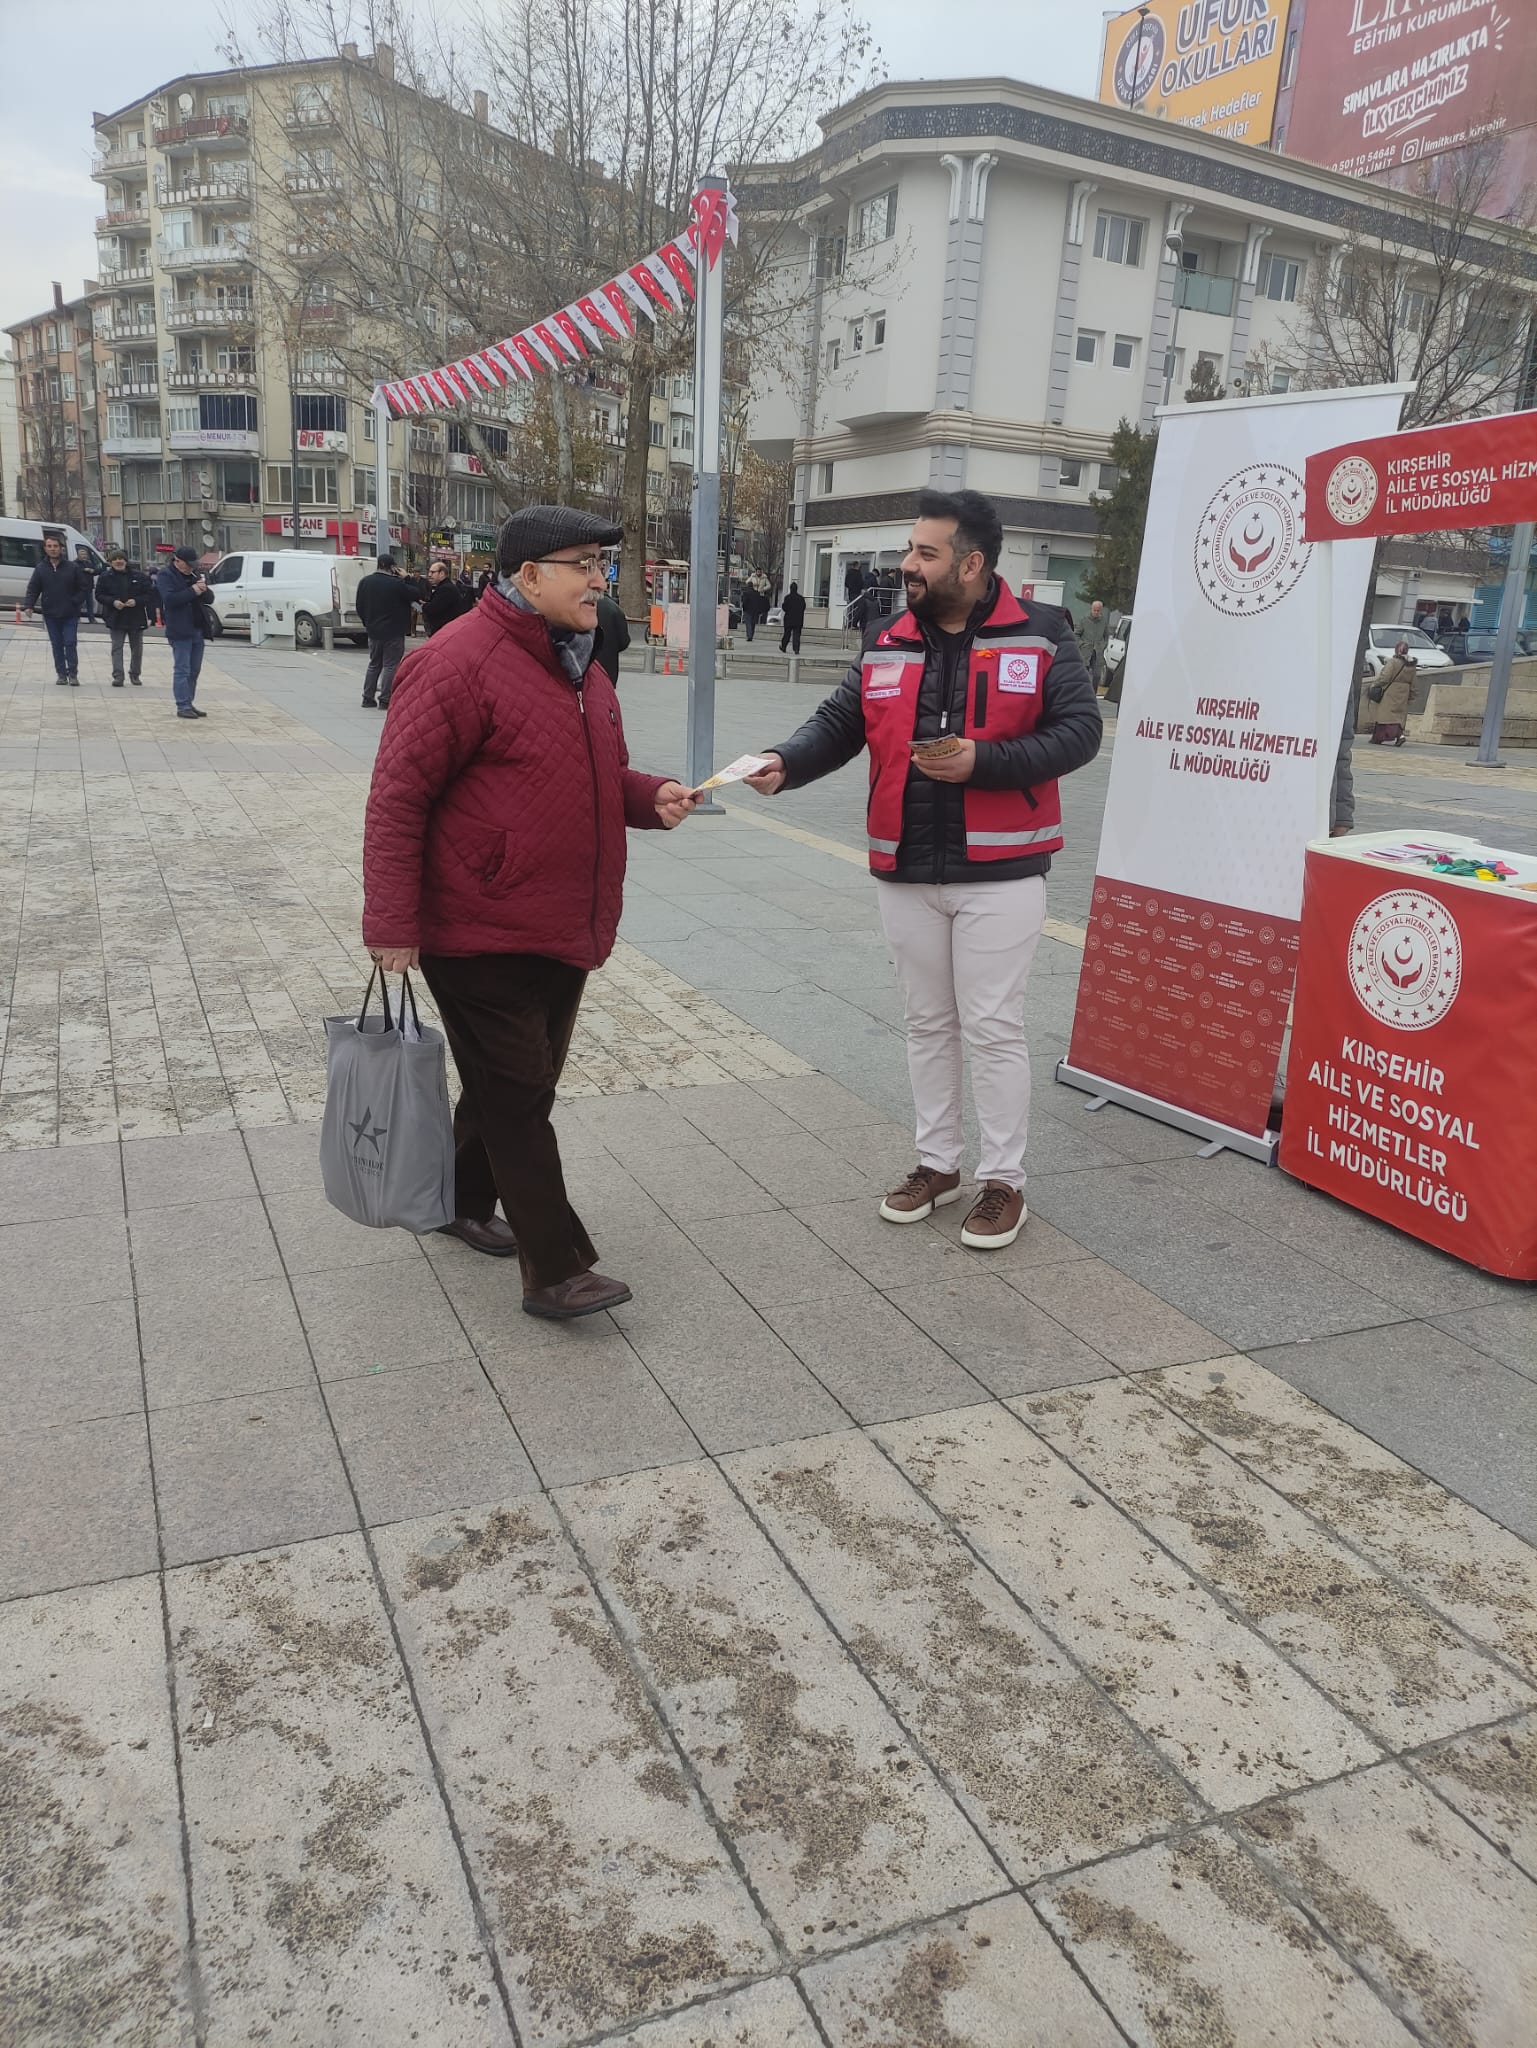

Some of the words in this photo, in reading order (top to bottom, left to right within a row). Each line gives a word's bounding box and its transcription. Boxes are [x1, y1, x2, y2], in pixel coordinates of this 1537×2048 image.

[1354, 22, 1402, 55] EĞİTİM
[1406, 0, 1495, 34] KURUMLA
[1160, 15, 1278, 97] OKULLARI
[1342, 66, 1408, 115] SINAVLARA
[1411, 25, 1488, 80] HAZIRLIKTA
[1176, 107, 1208, 128] ksek
[1210, 90, 1262, 122] Hedefler
[1387, 451, 1451, 475] KIRŞEHİR
[1386, 476, 1417, 495] AİLE
[1421, 475, 1438, 490] VE
[1442, 468, 1498, 487] SOSYAL
[1250, 491, 1259, 499] VE
[1260, 491, 1284, 509] SOSYAL
[1386, 496, 1398, 514] İL
[1401, 485, 1491, 512] MÜDÜRLÜĞÜ
[361, 523, 400, 539] ECNE
[1196, 697, 1260, 720] KIRŞEHİR
[1135, 716, 1164, 740] AİLE
[1167, 723, 1184, 741] VE
[1185, 725, 1236, 749] SOSYAL
[1169, 748, 1180, 770] İL
[1184, 752, 1271, 783] MÜDÜRLÜĞÜ
[1370, 934, 1379, 946] VE
[1376, 917, 1404, 936] SOSYAL
[1405, 917, 1438, 952] HİZMETLER
[1419, 953, 1439, 999] BAKANLIĞI
[1341, 1036, 1445, 1096] KIRŞEHİR
[1308, 1060, 1352, 1097] AİLE
[1357, 1079, 1385, 1111] VE
[1389, 1093, 1480, 1149] SOSYAL
[1328, 1103, 1447, 1176] HİZMETLER
[1307, 1126, 1324, 1158] İL
[1329, 1140, 1468, 1222] MÜDÜRLÜĞÜ
